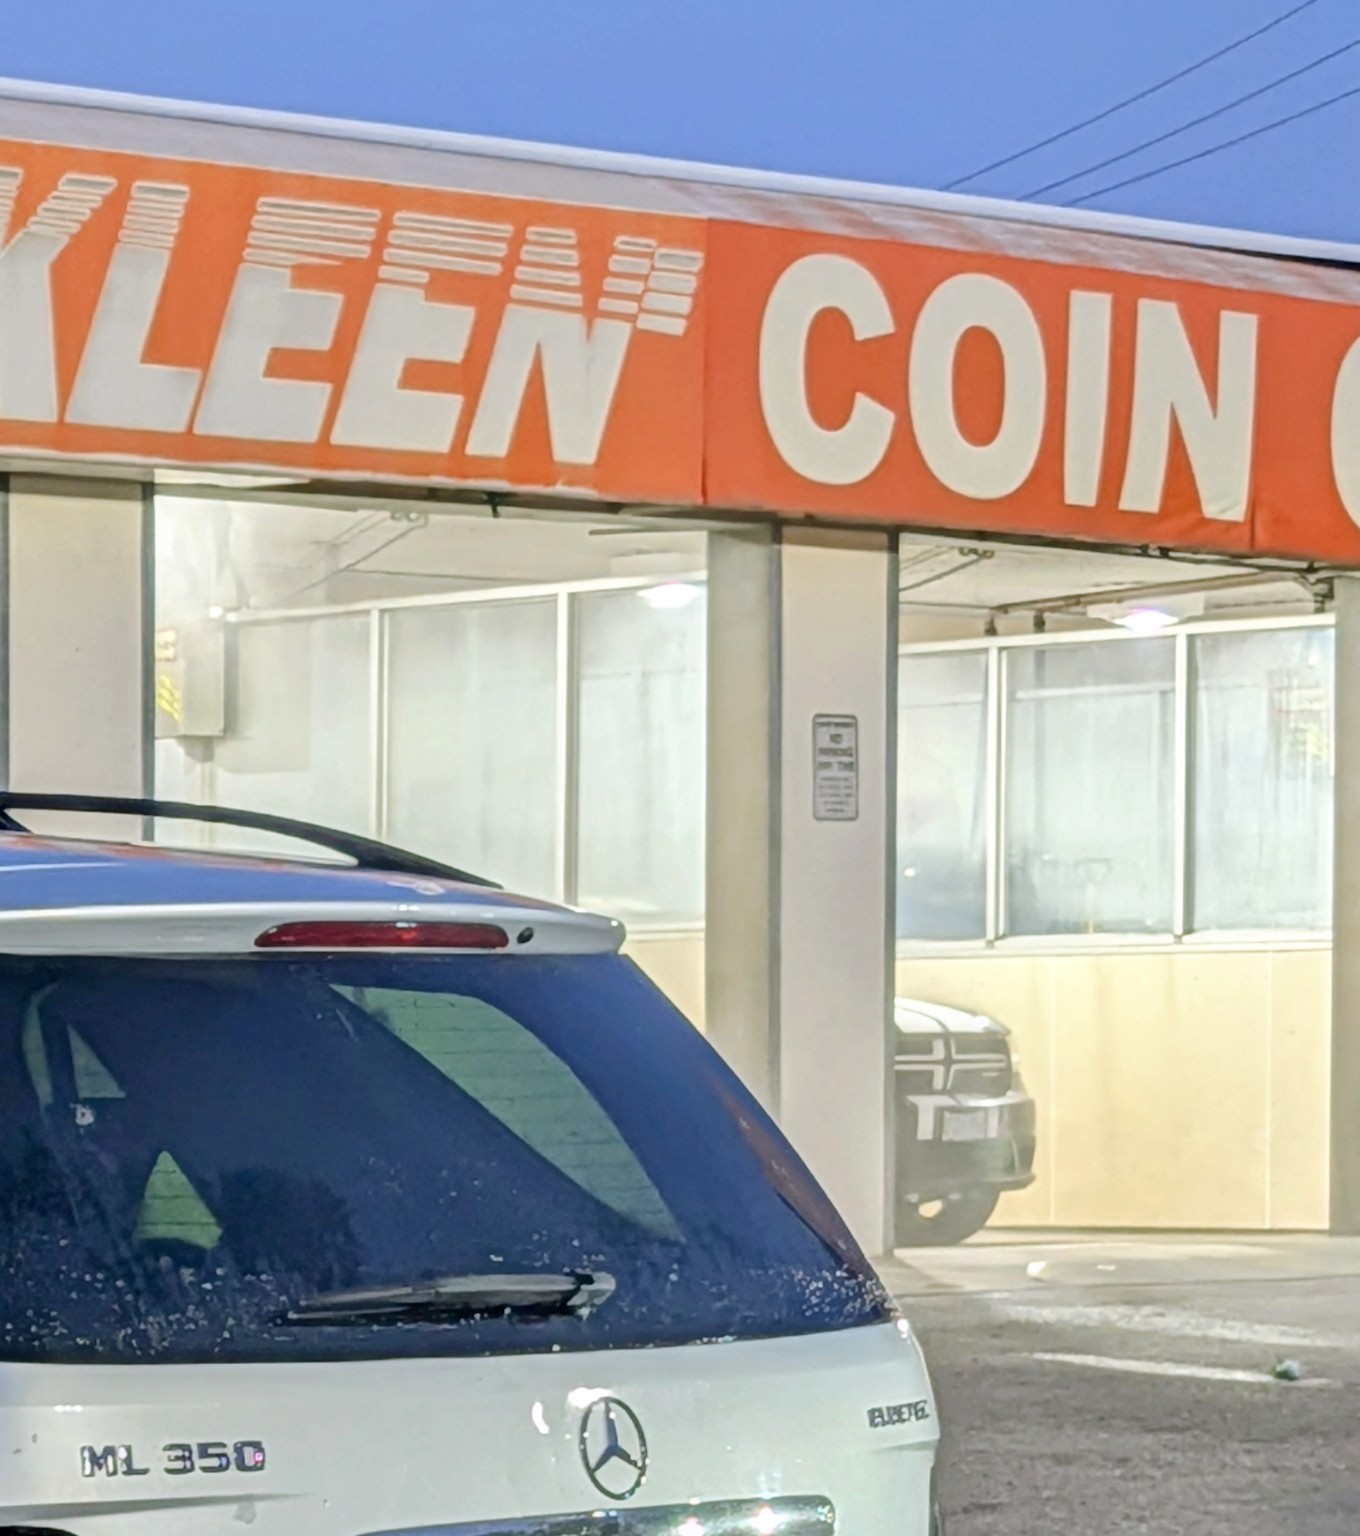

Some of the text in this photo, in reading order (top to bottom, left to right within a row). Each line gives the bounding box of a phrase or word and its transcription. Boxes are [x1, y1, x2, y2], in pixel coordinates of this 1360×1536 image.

[758, 252, 1259, 523] COIN
[80, 1440, 265, 1477] ML 350
